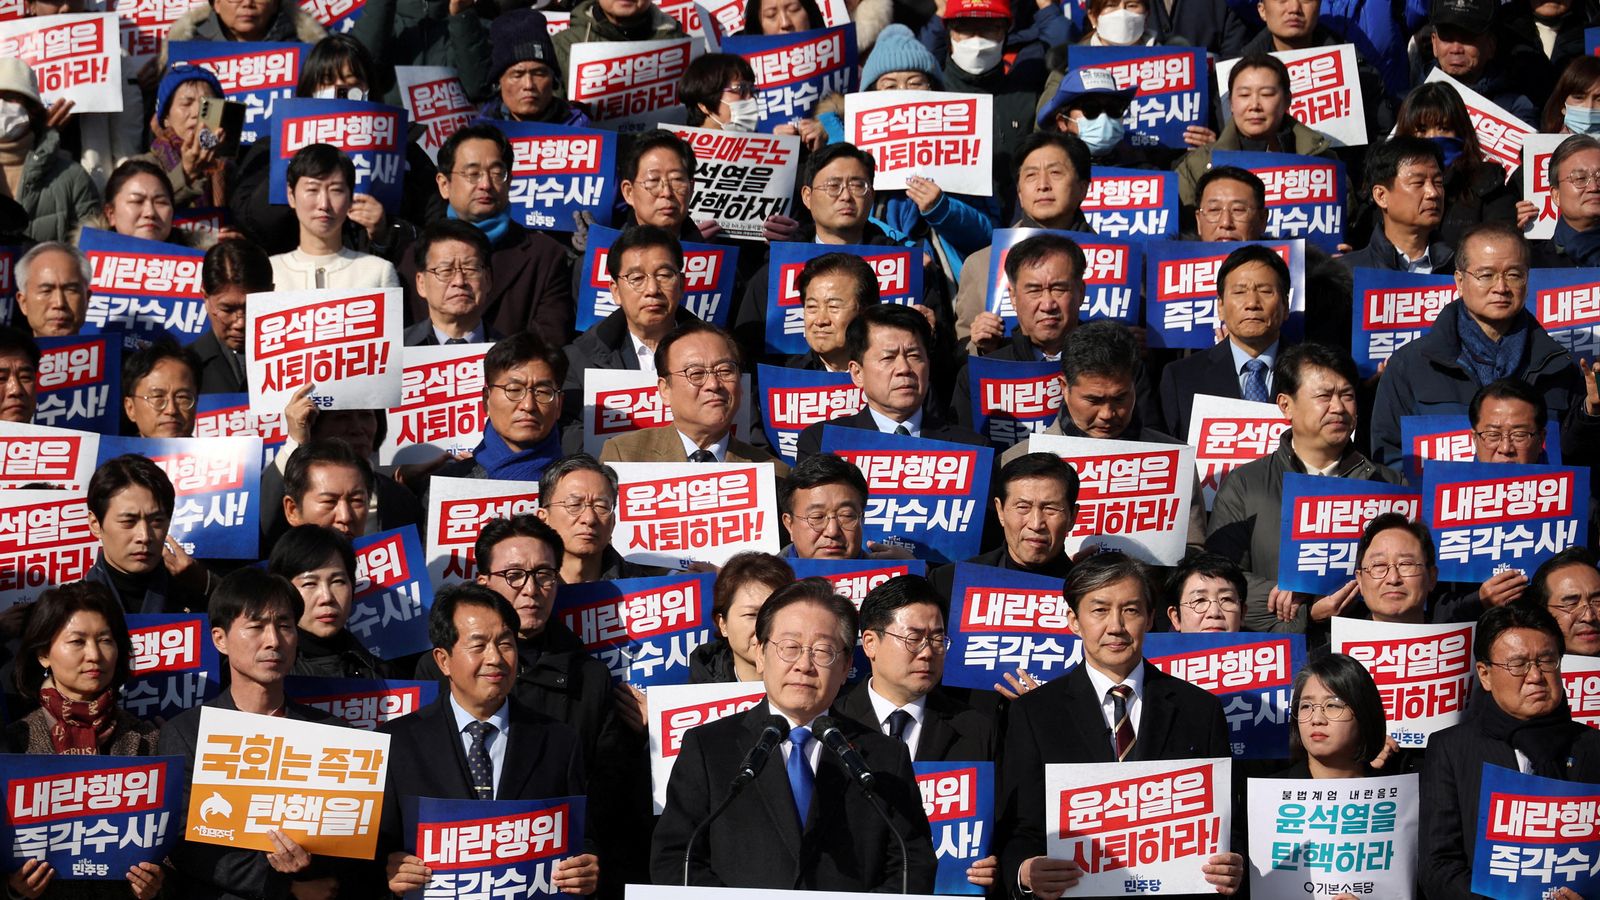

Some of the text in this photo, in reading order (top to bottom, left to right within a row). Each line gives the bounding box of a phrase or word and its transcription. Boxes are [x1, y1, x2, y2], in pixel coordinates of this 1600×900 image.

[37, 57, 110, 93] 하라!
[200, 52, 293, 90] 란행위
[579, 47, 684, 96] 윤석열은
[1108, 57, 1190, 92] 란행위
[1287, 56, 1338, 93] 열은
[413, 80, 470, 117] 윤석열
[1123, 92, 1200, 130] 각수사!
[1291, 89, 1351, 126] 하라!
[287, 116, 393, 151] 내란행위
[861, 103, 969, 142] 윤석열은
[354, 154, 402, 184] 수사!
[512, 139, 598, 171] 란행위
[508, 177, 604, 208] 각수사!
[694, 162, 773, 193] 석열을
[1081, 178, 1157, 206] 란행위
[1261, 168, 1332, 205] 란행위
[1088, 210, 1168, 240] 수사!
[1266, 206, 1341, 237] 각수사!
[91, 256, 204, 293] 내란행위
[1164, 258, 1222, 297] 내란
[85, 296, 208, 333] 즉각수사!
[1369, 289, 1459, 324] 내란행
[1542, 286, 1600, 324] 내란
[259, 299, 377, 355] 윤석열은
[38, 346, 99, 387] 행위
[262, 341, 390, 395] 사퇴하라!
[402, 359, 486, 405] 윤석열
[36, 385, 110, 425] 수사!
[603, 392, 670, 428] 윤석
[774, 389, 866, 425] 내란행
[986, 380, 1062, 413] 내란
[197, 409, 288, 438] 란행위
[396, 402, 488, 446] 사퇴하
[1205, 422, 1290, 455] 윤석
[3, 440, 71, 476] 열은
[1420, 433, 1477, 467] 내란
[1077, 455, 1169, 494] 석열은
[173, 492, 249, 533] 수사!
[626, 473, 749, 517] 윤석열은
[1440, 477, 1567, 521] 내란행위
[0, 505, 91, 551] 석열은
[629, 511, 764, 551] 사퇴하라!
[864, 499, 976, 532] 각수사!
[1072, 498, 1180, 538] 퇴하라!
[1438, 519, 1578, 563] 즉각수사!
[0, 546, 103, 592] 퇴하라
[347, 581, 421, 637] 수사!
[565, 586, 695, 645] 내란행위
[969, 592, 1069, 629] 내란행
[130, 627, 194, 671] 행위
[602, 629, 708, 682] 각수사
[964, 635, 1082, 671] 즉각수
[1349, 634, 1466, 680] 윤석열은
[126, 671, 208, 716] 수사!
[1380, 676, 1473, 721] 퇴하라!
[202, 734, 384, 785] 국회는 즉각
[14, 768, 159, 818] 내란행위
[1068, 771, 1205, 832] 윤석열은
[244, 793, 374, 836] 탄핵을!
[1276, 801, 1397, 835] 윤석열을
[1493, 799, 1600, 838] 내란행
[13, 812, 169, 861] 즉각수사!
[424, 811, 562, 864] 내란행위
[1073, 816, 1220, 874] 사퇴하라!
[72, 862, 110, 876] 민주당
[1271, 840, 1395, 873] 탄핵하라
[1489, 844, 1600, 884] 즉각수
[424, 857, 563, 900] 즉각수사
[1124, 879, 1161, 893] 민주당
[1316, 882, 1374, 896] 기본소득당
